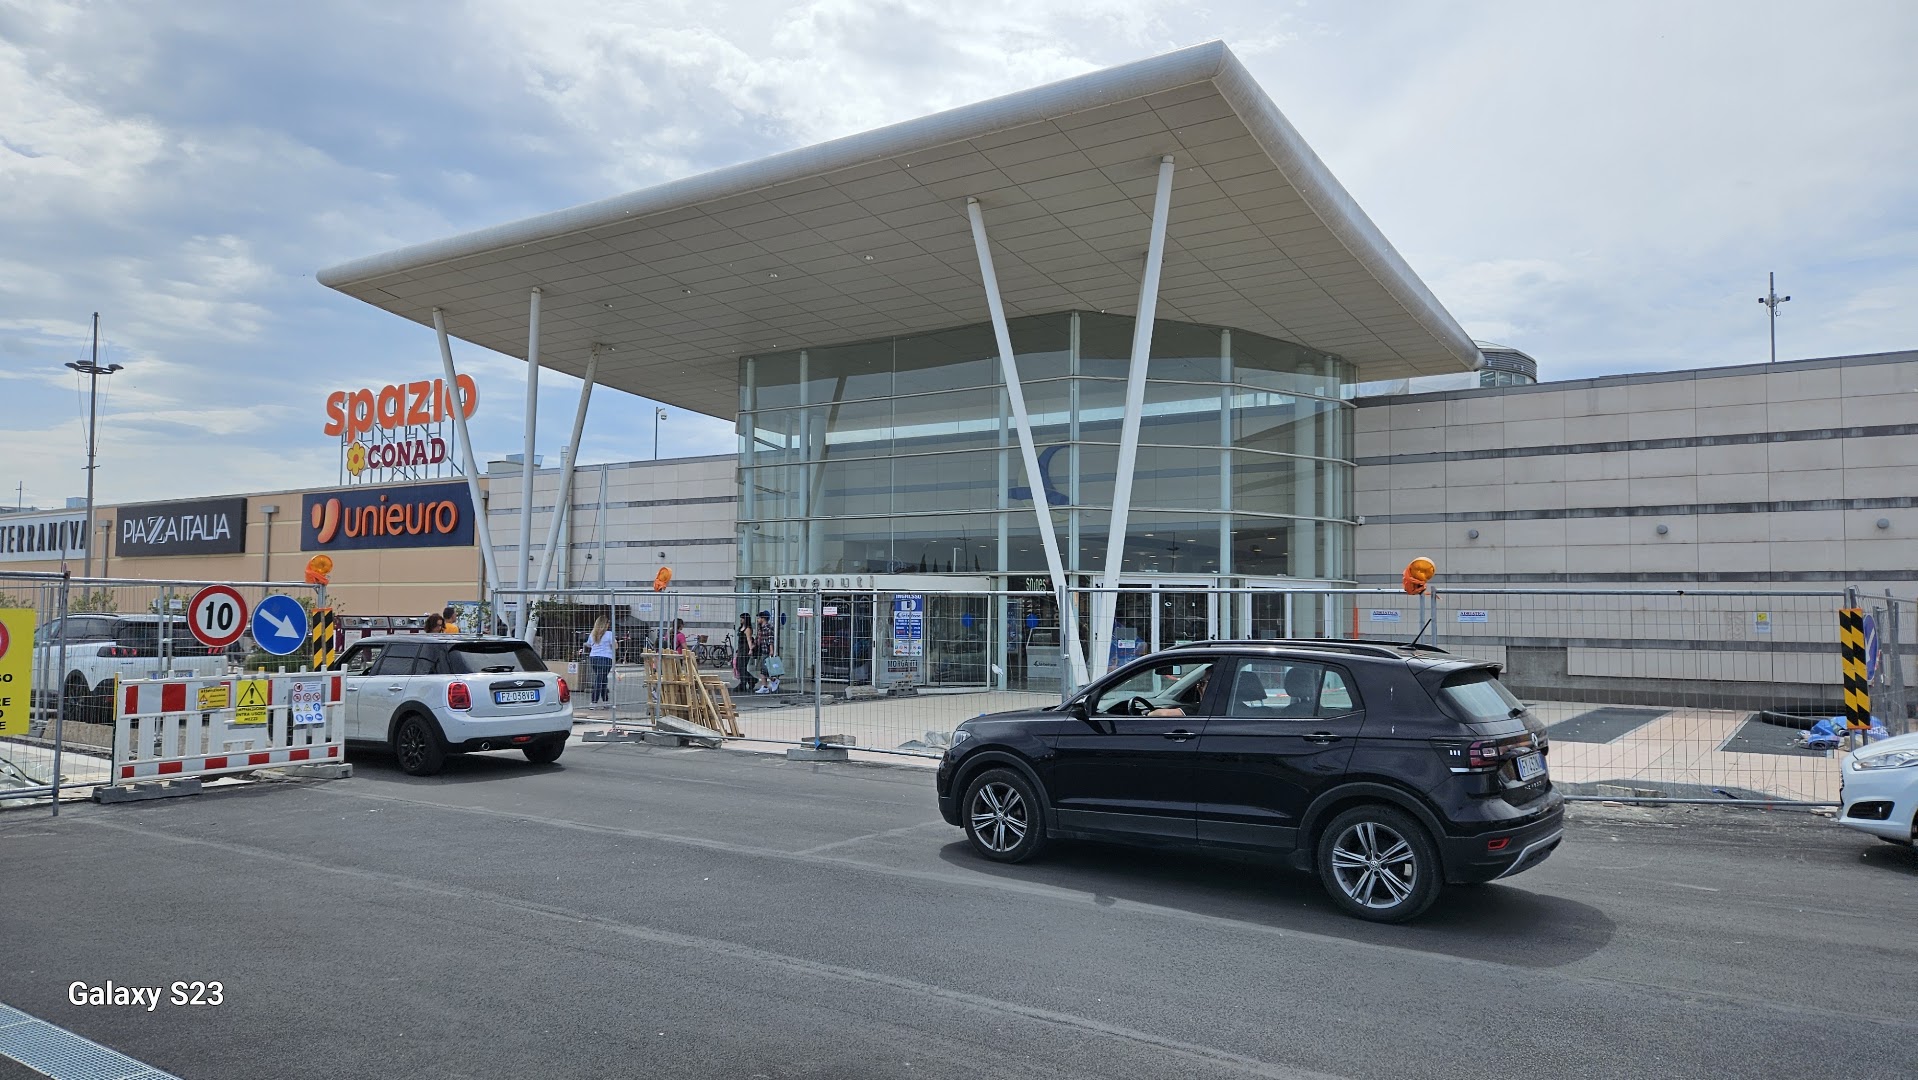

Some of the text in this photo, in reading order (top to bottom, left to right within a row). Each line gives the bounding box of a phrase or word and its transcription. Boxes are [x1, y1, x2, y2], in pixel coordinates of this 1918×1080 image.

[323, 373, 479, 444] spazio
[367, 437, 447, 469] CONAD
[344, 494, 459, 538] unieuro
[205, 601, 234, 631] 10
